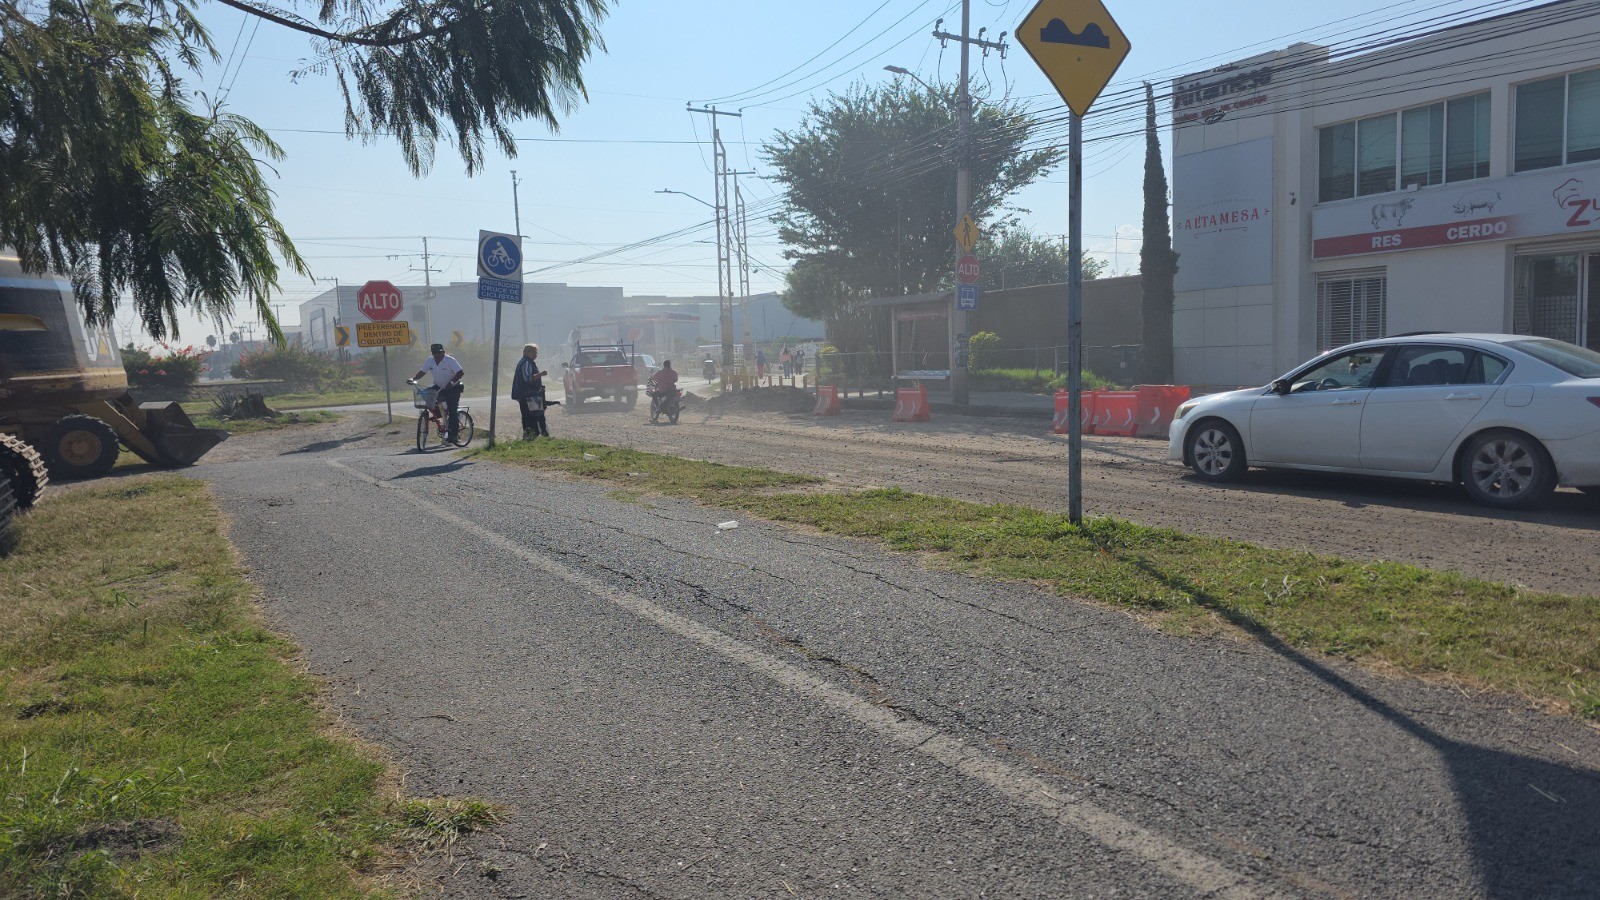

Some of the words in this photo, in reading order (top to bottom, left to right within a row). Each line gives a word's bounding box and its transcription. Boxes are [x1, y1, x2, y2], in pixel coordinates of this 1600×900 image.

[1185, 207, 1259, 230] ALTAMESA
[1446, 221, 1507, 240] CERDO
[1371, 233, 1402, 248] RES
[958, 264, 979, 276] ALTO
[481, 285, 507, 294] CRUCE
[362, 293, 399, 310] ALTO
[481, 291, 520, 301] CICLISTAS
[358, 322, 407, 331] PREFERENCIA
[363, 330, 393, 338] DENTRO
[367, 337, 402, 345] GLORIETA
